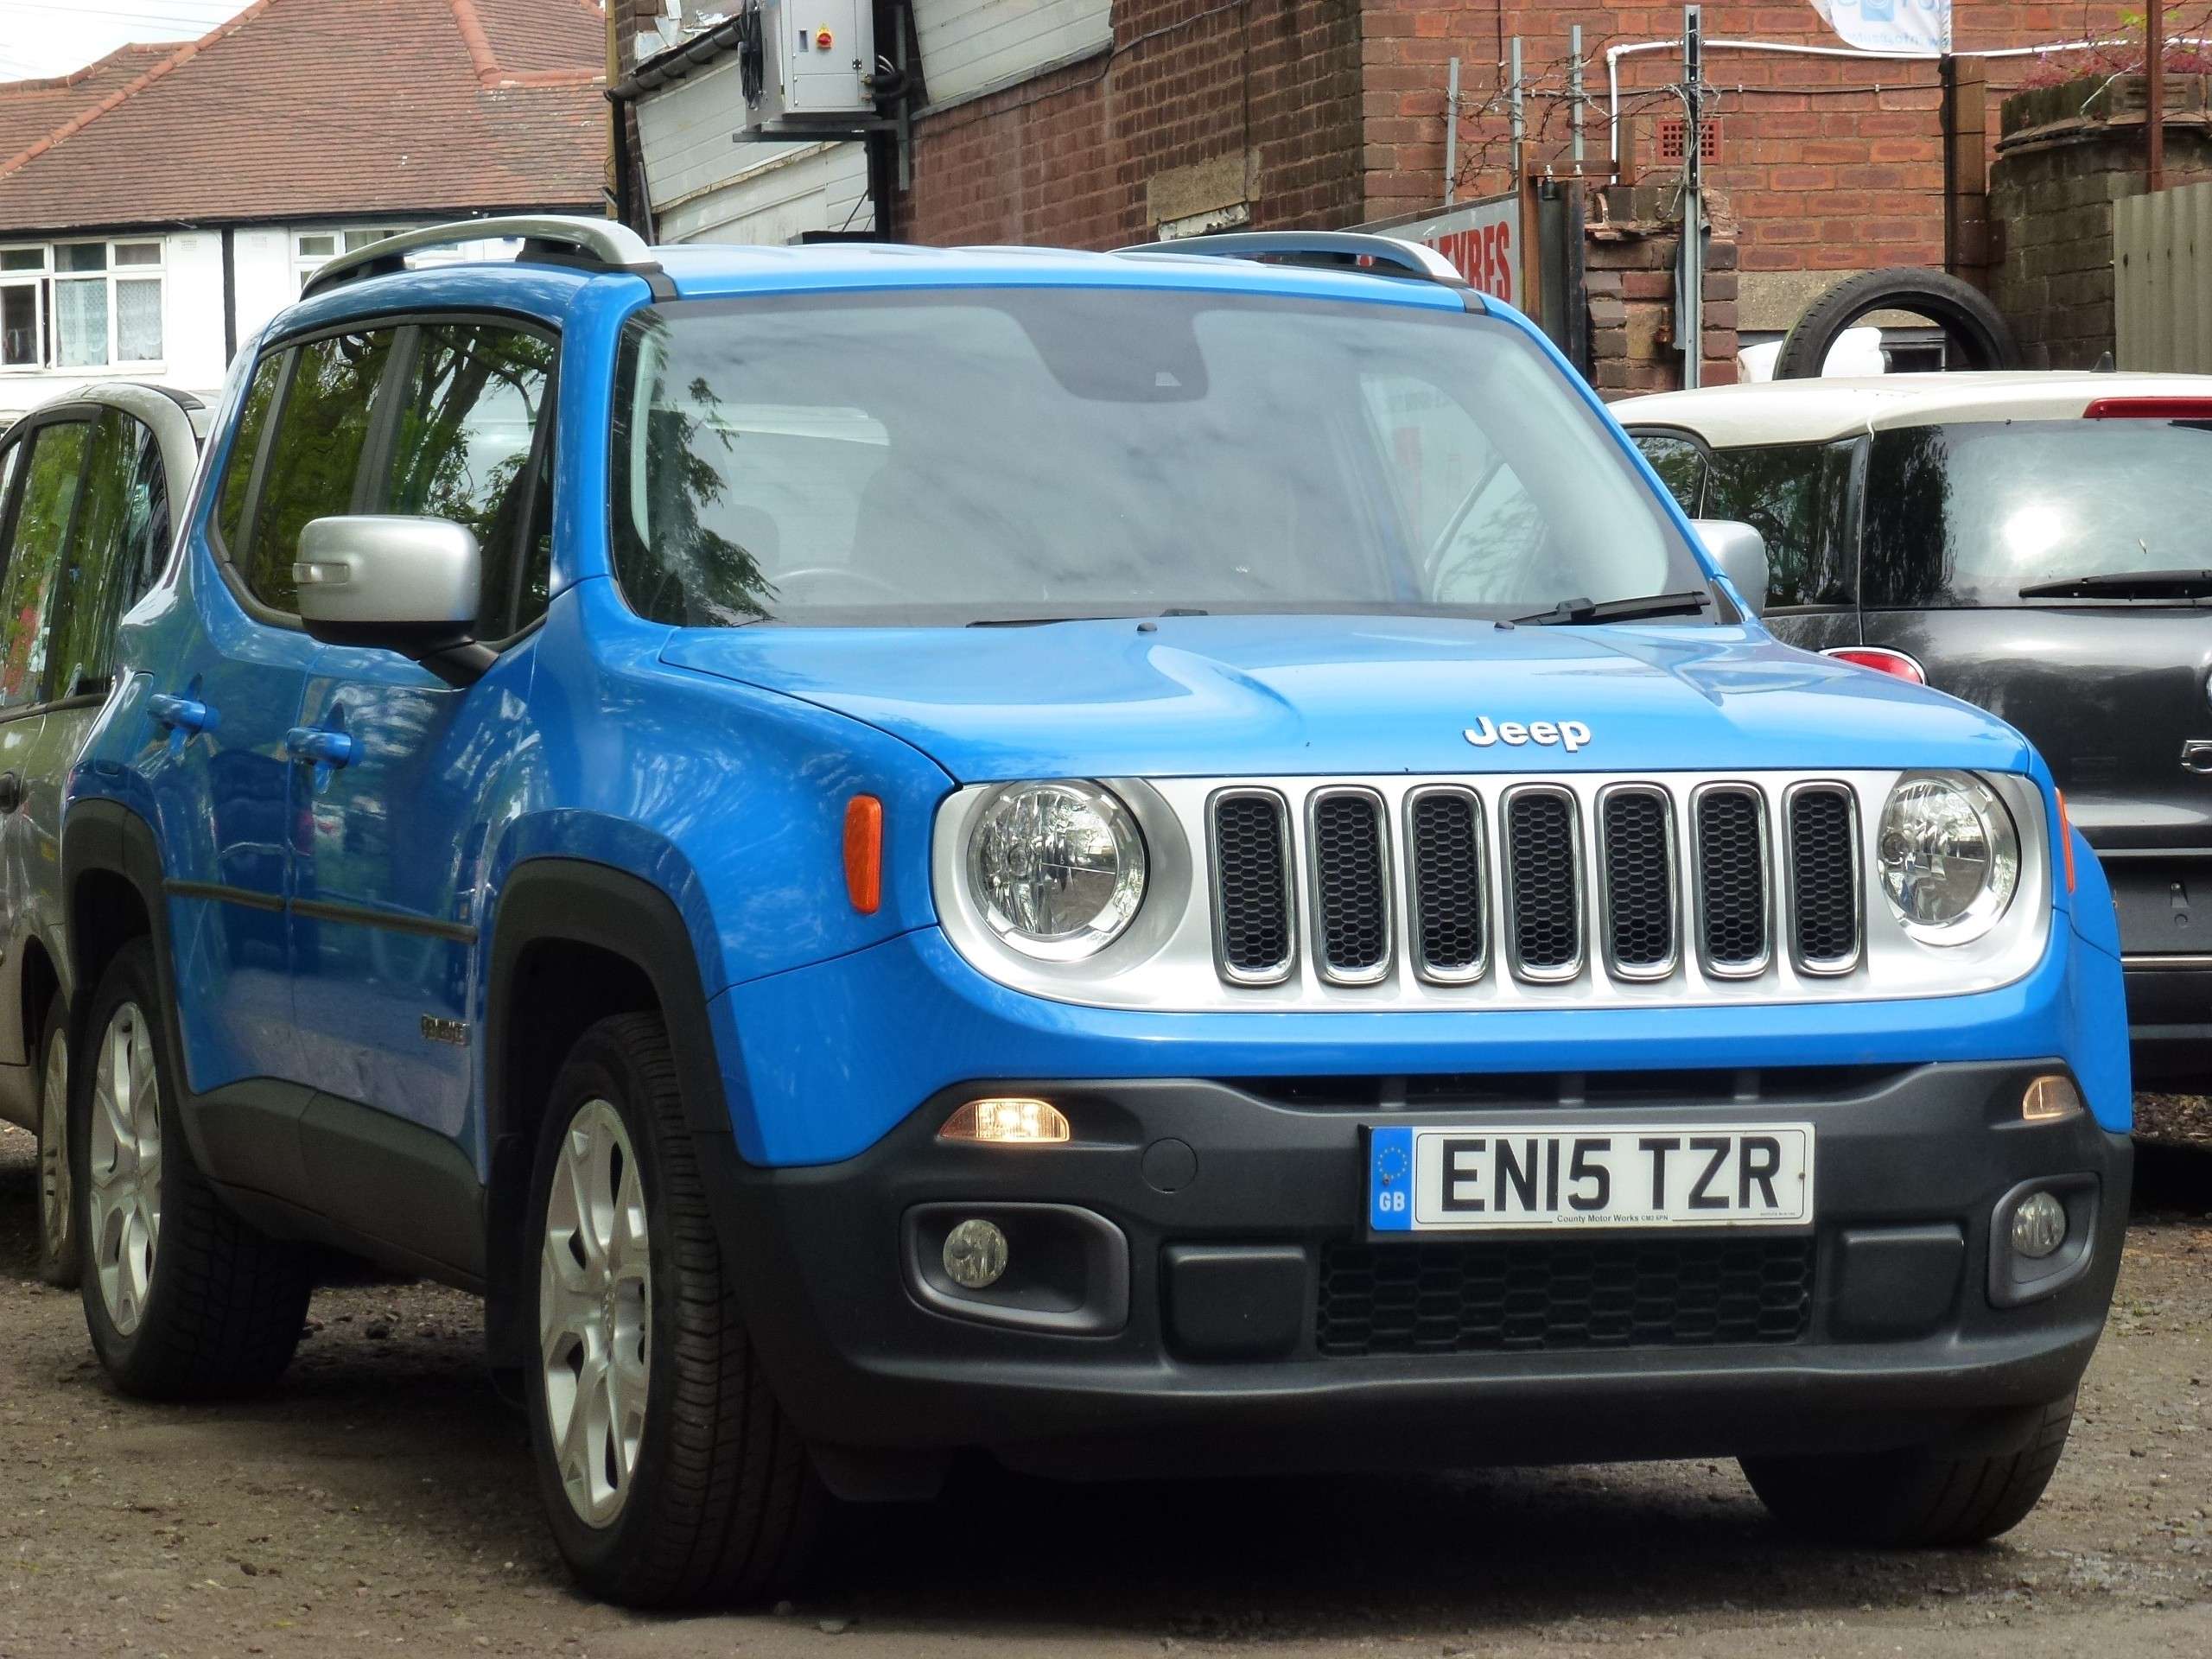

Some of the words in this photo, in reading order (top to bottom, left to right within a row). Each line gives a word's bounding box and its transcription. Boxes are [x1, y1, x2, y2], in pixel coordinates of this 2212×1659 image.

[1462, 716, 1592, 753] Jeep
[1440, 1138, 1611, 1212] EN15
[1638, 1136, 1781, 1211] TZR
[1378, 1192, 1406, 1212] GB
[1557, 1214, 1585, 1224] County
